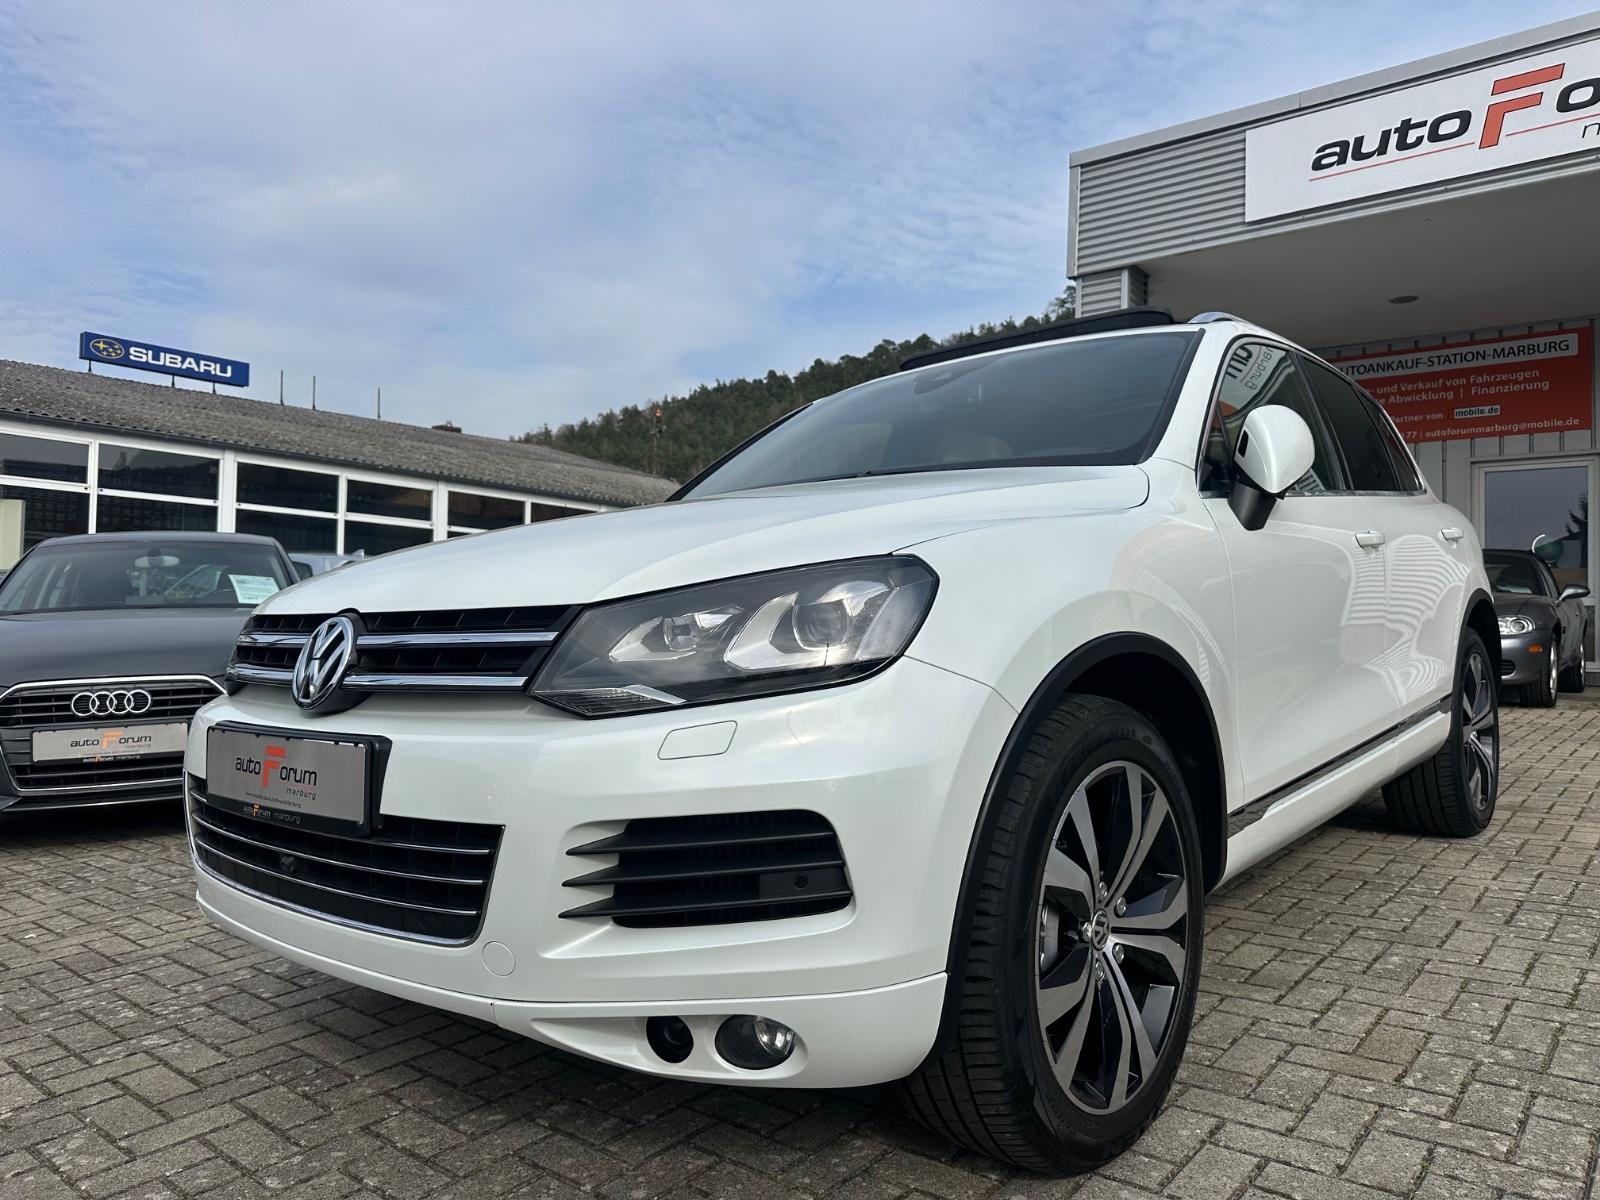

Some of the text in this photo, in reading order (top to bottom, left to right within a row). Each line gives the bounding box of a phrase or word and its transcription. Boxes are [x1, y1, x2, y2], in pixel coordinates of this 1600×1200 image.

[129, 346, 232, 378] SUBARU
[1340, 339, 1570, 376] UTOANKAUF-STATION-MARBURG
[1376, 369, 1540, 394] und Verkauf von Fahrzeugen
[1388, 391, 1454, 404] Abwicklung
[1471, 381, 1550, 396] Finanzierung
[1425, 412, 1444, 421] von
[1455, 406, 1499, 418] mobile.de
[1425, 417, 1580, 438] autoforummarburg@mobile.de
[69, 729, 152, 751] autoForum
[235, 745, 318, 787] autoForum
[286, 787, 317, 801] marburg
